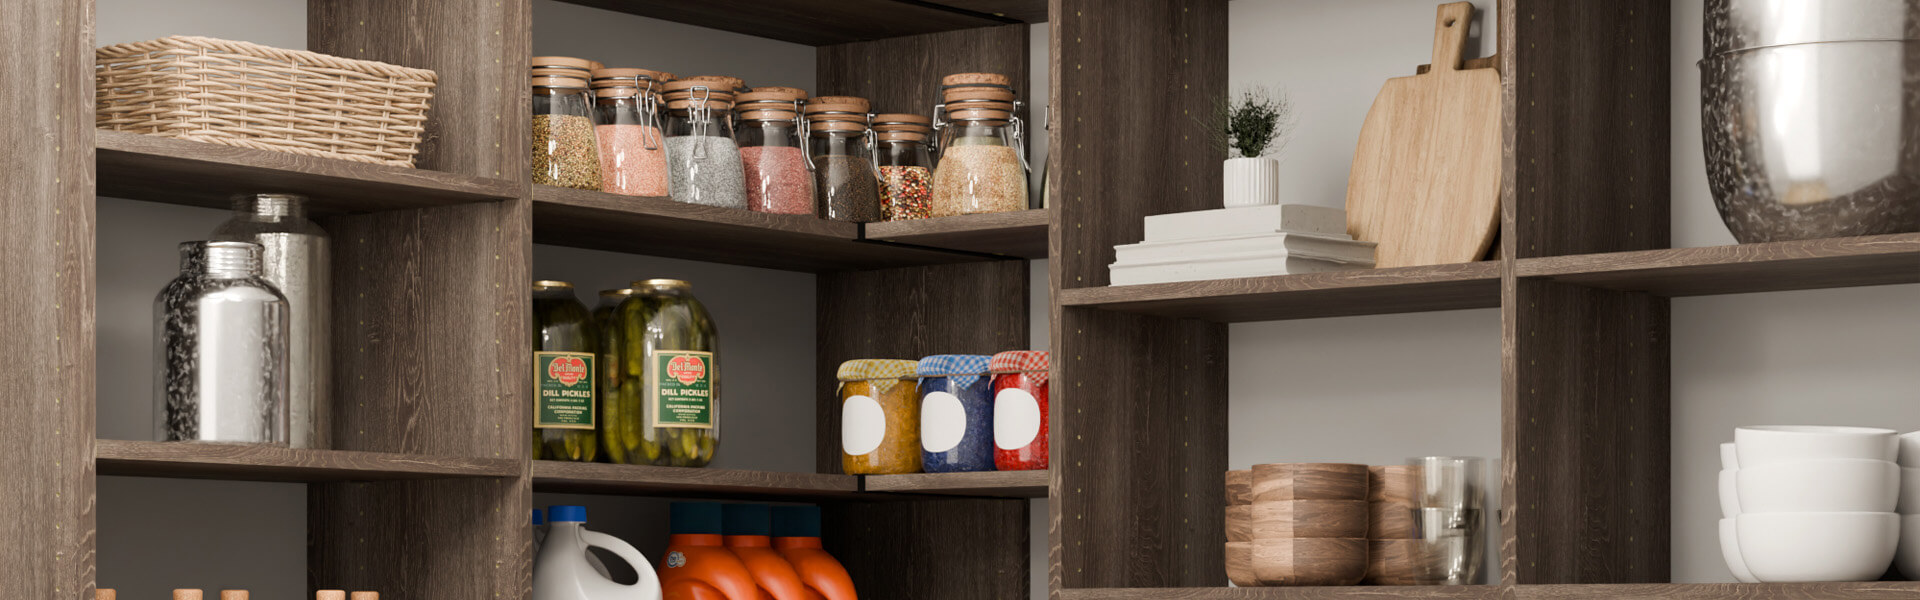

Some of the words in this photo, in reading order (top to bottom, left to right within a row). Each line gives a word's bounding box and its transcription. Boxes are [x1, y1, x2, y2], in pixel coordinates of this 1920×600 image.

[552, 363, 565, 372] Del
[566, 363, 584, 373] Monte
[671, 362, 683, 371] Del
[684, 362, 702, 372] Monte
[680, 389, 708, 397] PICKLES
